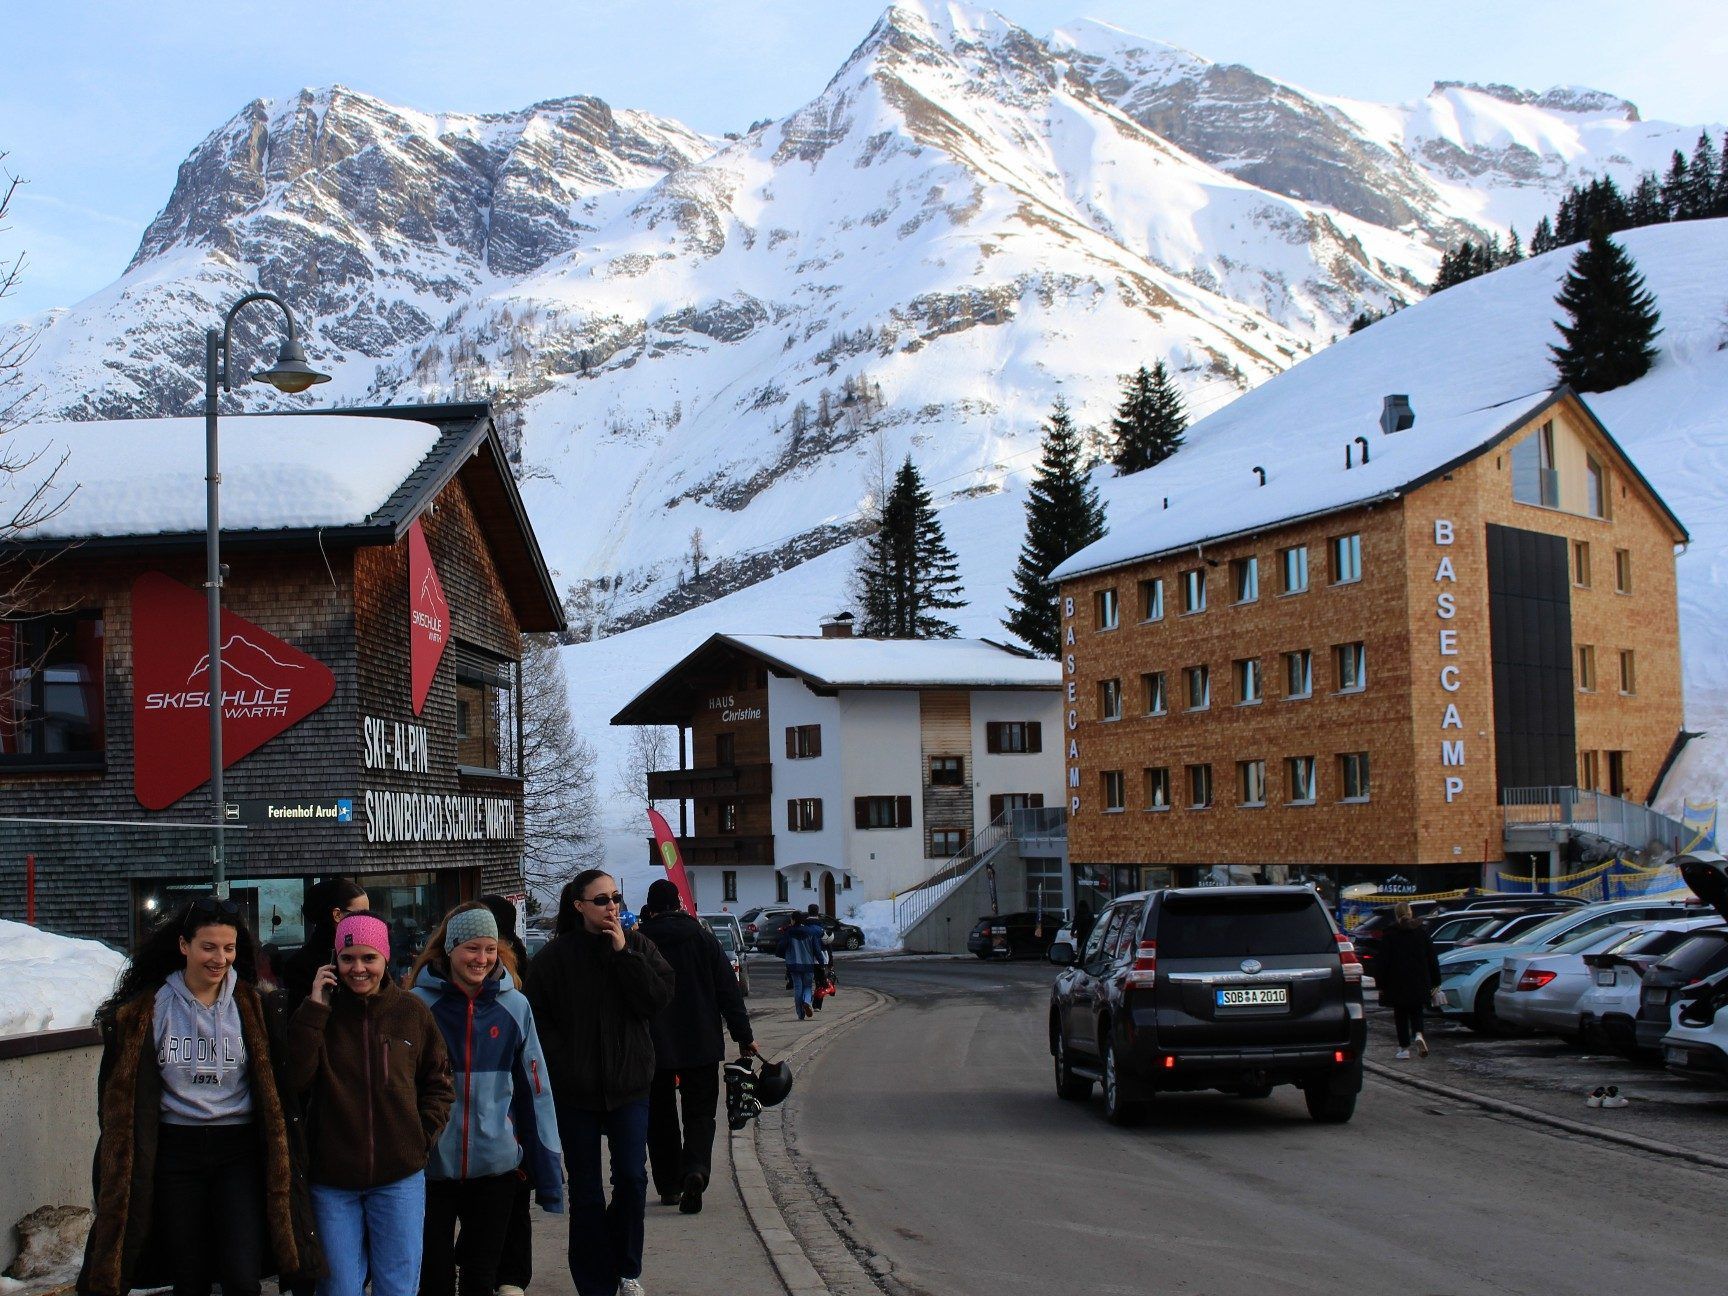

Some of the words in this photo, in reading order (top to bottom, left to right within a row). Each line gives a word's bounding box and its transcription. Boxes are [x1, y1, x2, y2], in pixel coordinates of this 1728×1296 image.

[1434, 519, 1465, 803] BASECAMP
[709, 695, 735, 709] HAUS
[1065, 597, 1080, 817] BASECAMP
[224, 706, 287, 719] WARTH
[722, 707, 761, 722] Christine
[268, 804, 314, 818] Ferienhof
[315, 804, 338, 818] Arud
[365, 789, 443, 843] SNOWBOARD
[444, 794, 483, 841] SCHULE
[484, 797, 515, 840] WARTH
[1377, 884, 1417, 893] BASECAMP
[1224, 991, 1244, 1004] SOB
[1251, 991, 1258, 1003] A
[1260, 990, 1286, 1003] 2010
